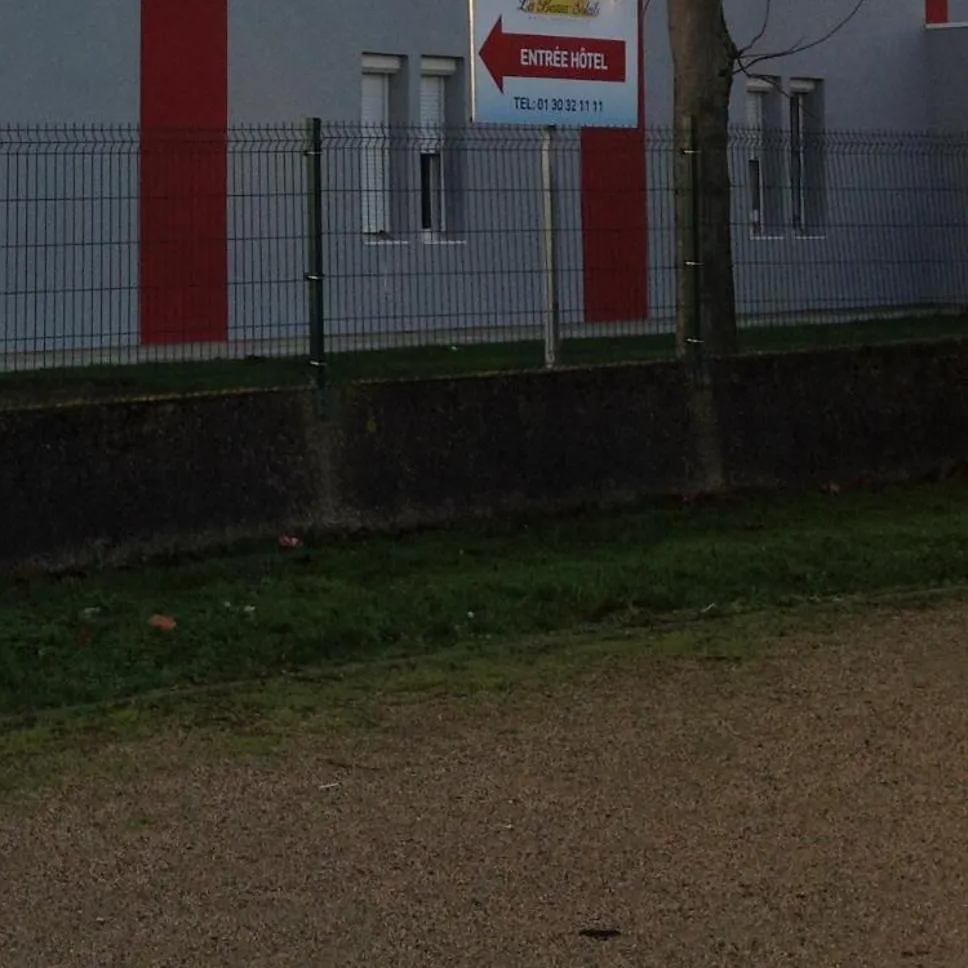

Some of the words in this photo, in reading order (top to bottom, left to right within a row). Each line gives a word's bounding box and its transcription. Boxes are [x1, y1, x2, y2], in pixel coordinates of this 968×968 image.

[520, 46, 569, 68] ENTRÉE
[571, 47, 608, 70] HÔTEL
[537, 98, 549, 111] 01
[551, 98, 563, 111] 30
[565, 98, 577, 112] 32
[580, 99, 590, 112] 11
[593, 100, 603, 112] 11
